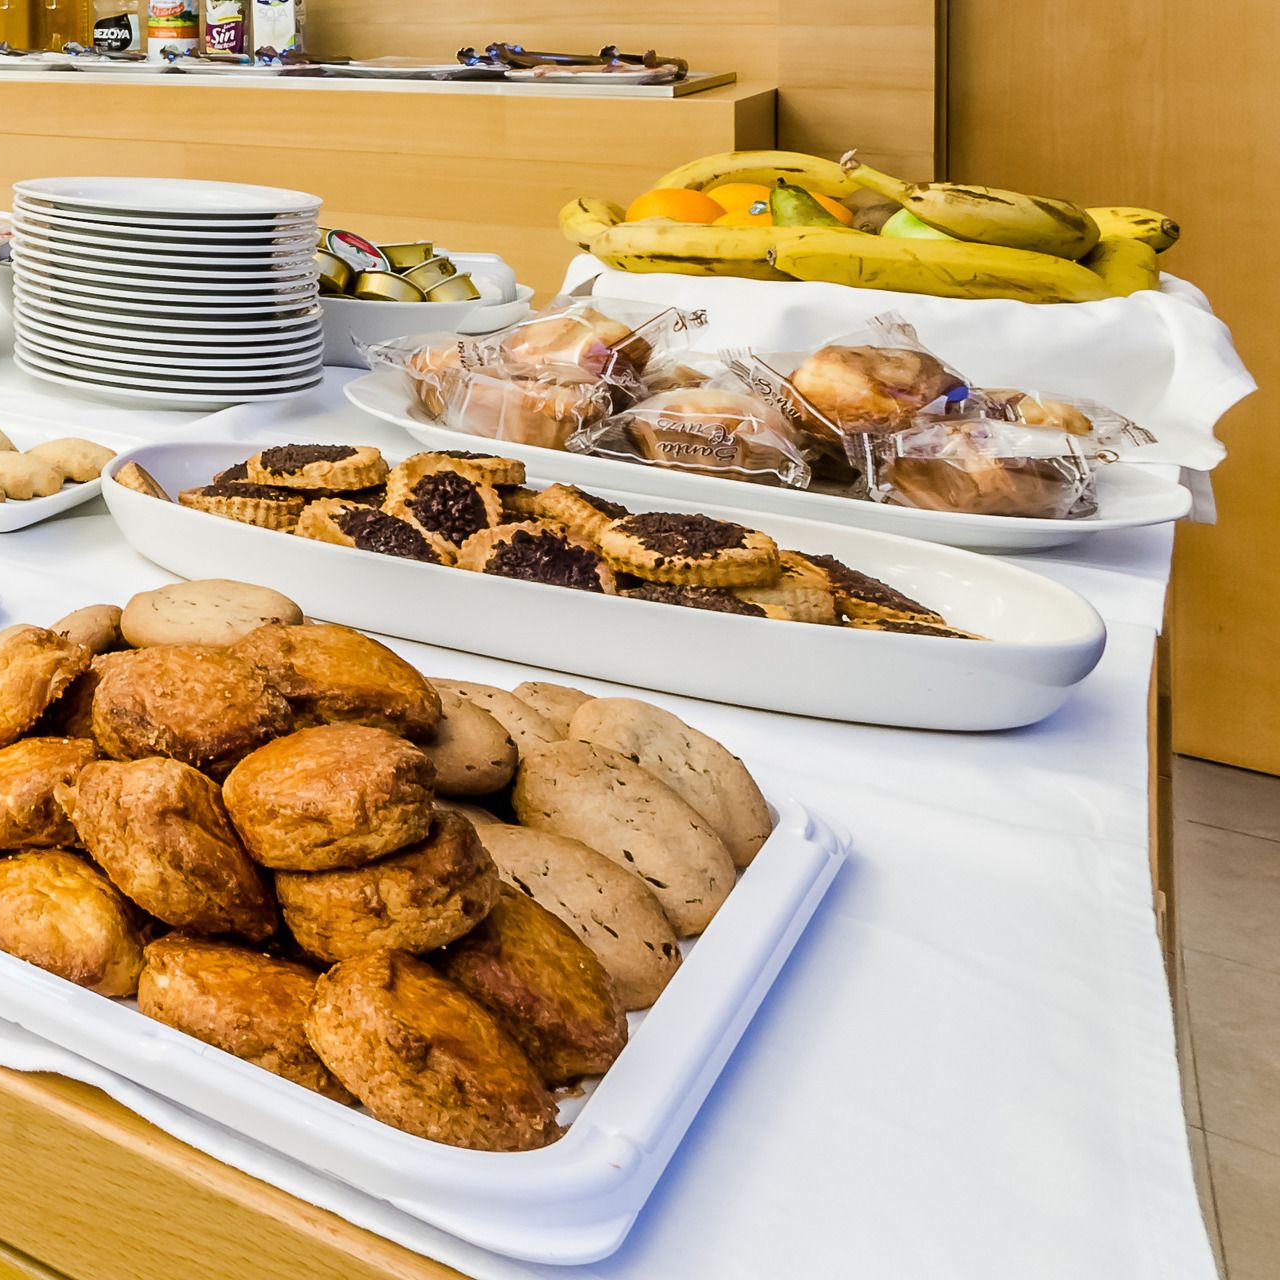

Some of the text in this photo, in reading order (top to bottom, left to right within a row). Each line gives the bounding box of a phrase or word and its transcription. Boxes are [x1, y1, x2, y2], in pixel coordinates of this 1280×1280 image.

[93, 27, 131, 40] BEZOYA
[211, 27, 236, 45] Sin
[656, 441, 739, 462] Santa
